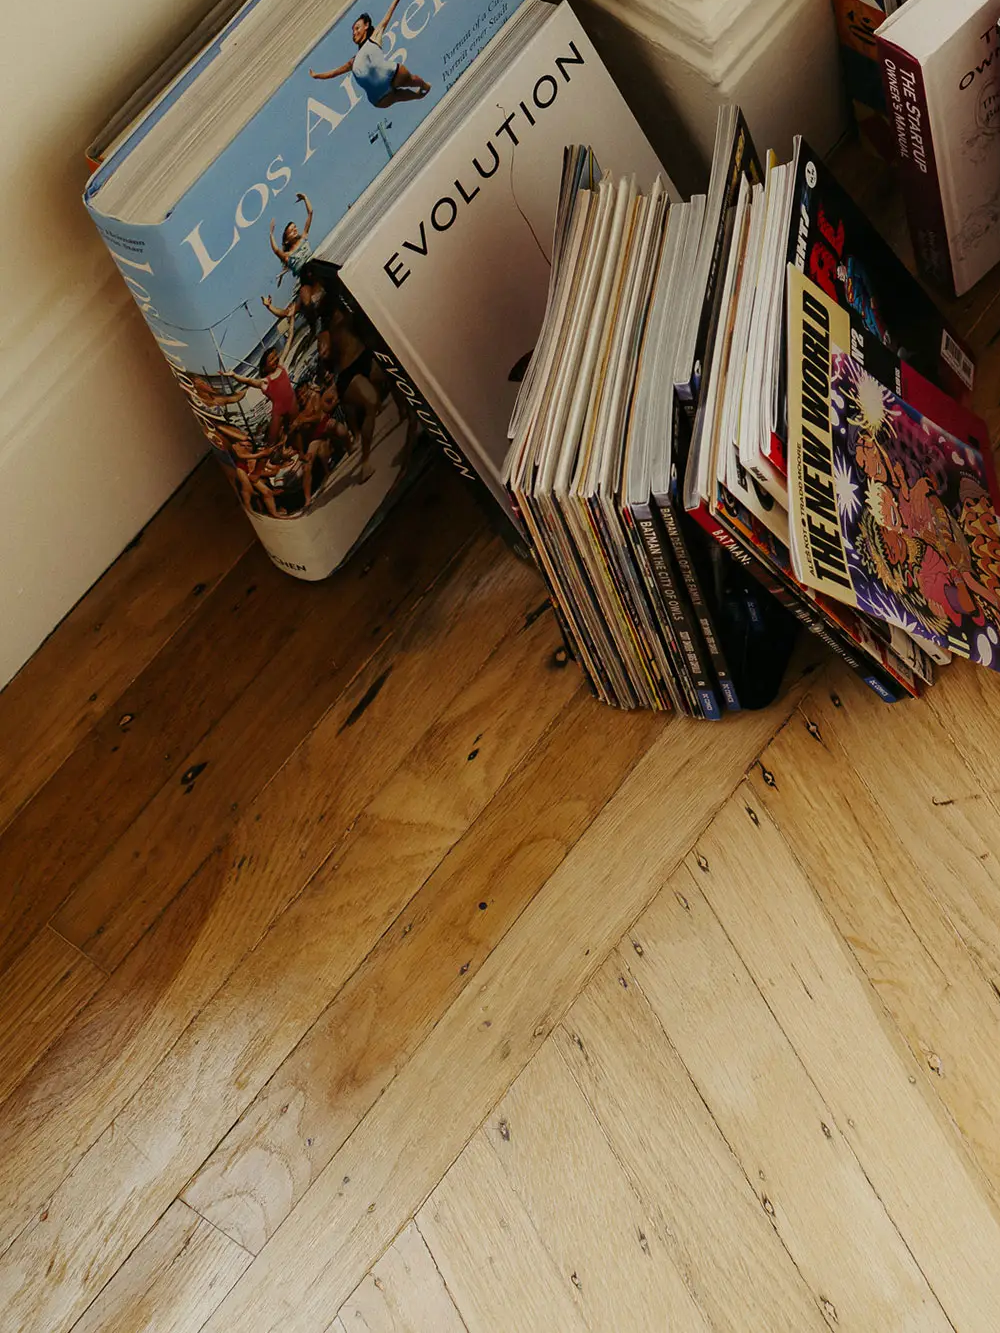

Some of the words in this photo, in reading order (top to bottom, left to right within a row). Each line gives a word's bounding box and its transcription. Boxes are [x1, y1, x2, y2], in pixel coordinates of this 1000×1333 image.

[899, 68, 916, 104] THE
[884, 58, 901, 110] OWNER'S
[893, 109, 908, 158] MANUAL
[906, 104, 928, 173] STARTUP
[383, 40, 585, 289] EVOLUTION
[181, 154, 292, 283] Los
[802, 290, 831, 433] WORLD
[373, 350, 476, 480] EVOLUTION
[802, 424, 839, 526] NEW
[798, 482, 806, 518] TRADD
[640, 521, 662, 555] BATMAN
[660, 507, 678, 535] BATMAN
[801, 528, 809, 550] KOT
[652, 553, 668, 570] THE
[711, 528, 752, 566] BATMAN:
[807, 515, 852, 590] THE
[658, 569, 672, 590] CITY
[666, 588, 677, 601] OF
[668, 599, 685, 621] OWLS
